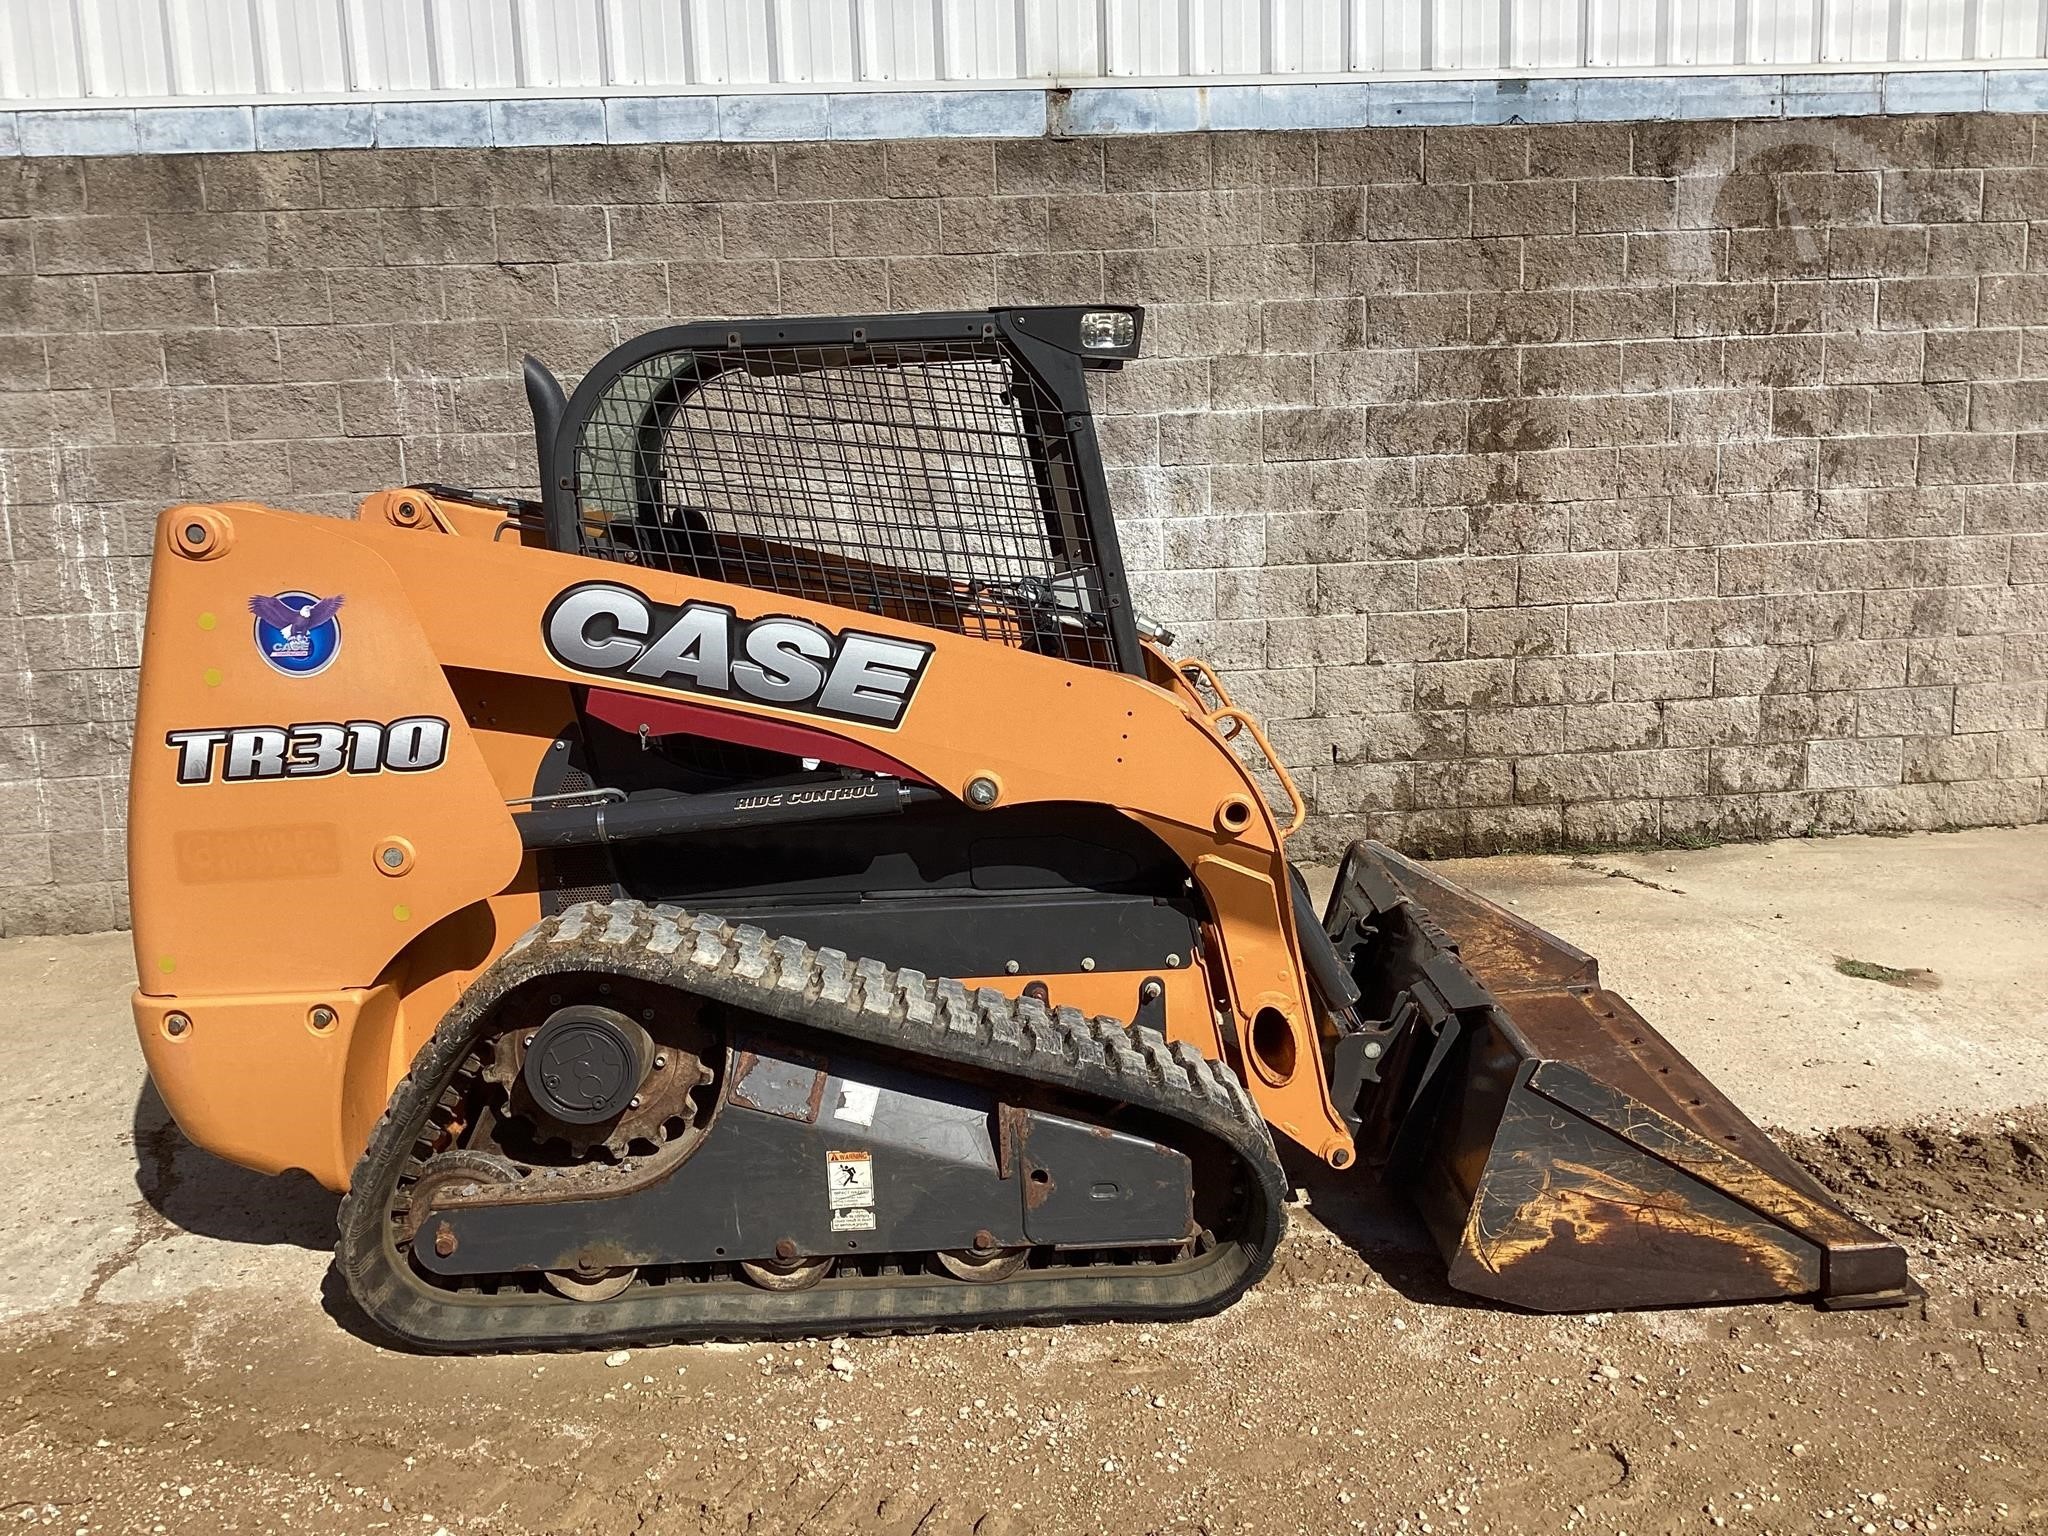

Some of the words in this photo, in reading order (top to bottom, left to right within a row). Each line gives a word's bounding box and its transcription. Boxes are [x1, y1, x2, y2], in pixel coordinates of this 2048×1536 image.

[547, 586, 928, 723] CASE
[168, 718, 448, 784] TR310
[734, 794, 783, 810] RIDE
[787, 785, 879, 805] CONTROL
[839, 1152, 868, 1160] WARNING
